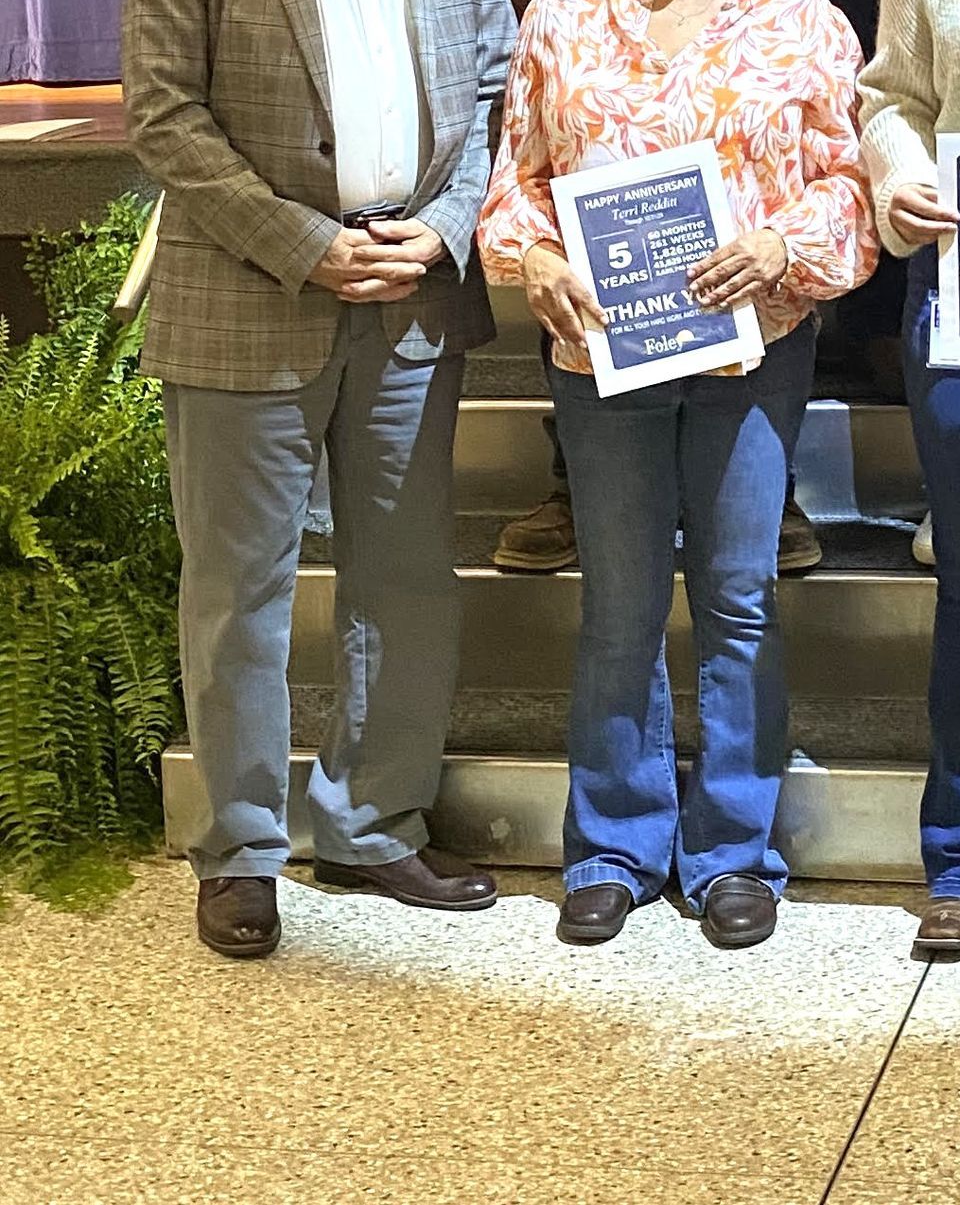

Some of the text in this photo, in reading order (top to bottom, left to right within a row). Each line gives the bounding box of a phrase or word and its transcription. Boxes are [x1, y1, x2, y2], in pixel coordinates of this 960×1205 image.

[583, 175, 698, 210] HAPPY ANNIVERSARY
[611, 204, 638, 220] Terri
[639, 195, 678, 214] Redditt
[646, 219, 706, 240] 60 MONTHS
[649, 229, 704, 249] 261 WEEKS
[605, 240, 634, 271] 5
[651, 237, 715, 260] 1,826 DAYS
[599, 268, 648, 290] YEARS
[604, 292, 678, 325] THANK
[643, 331, 683, 358] Foley
